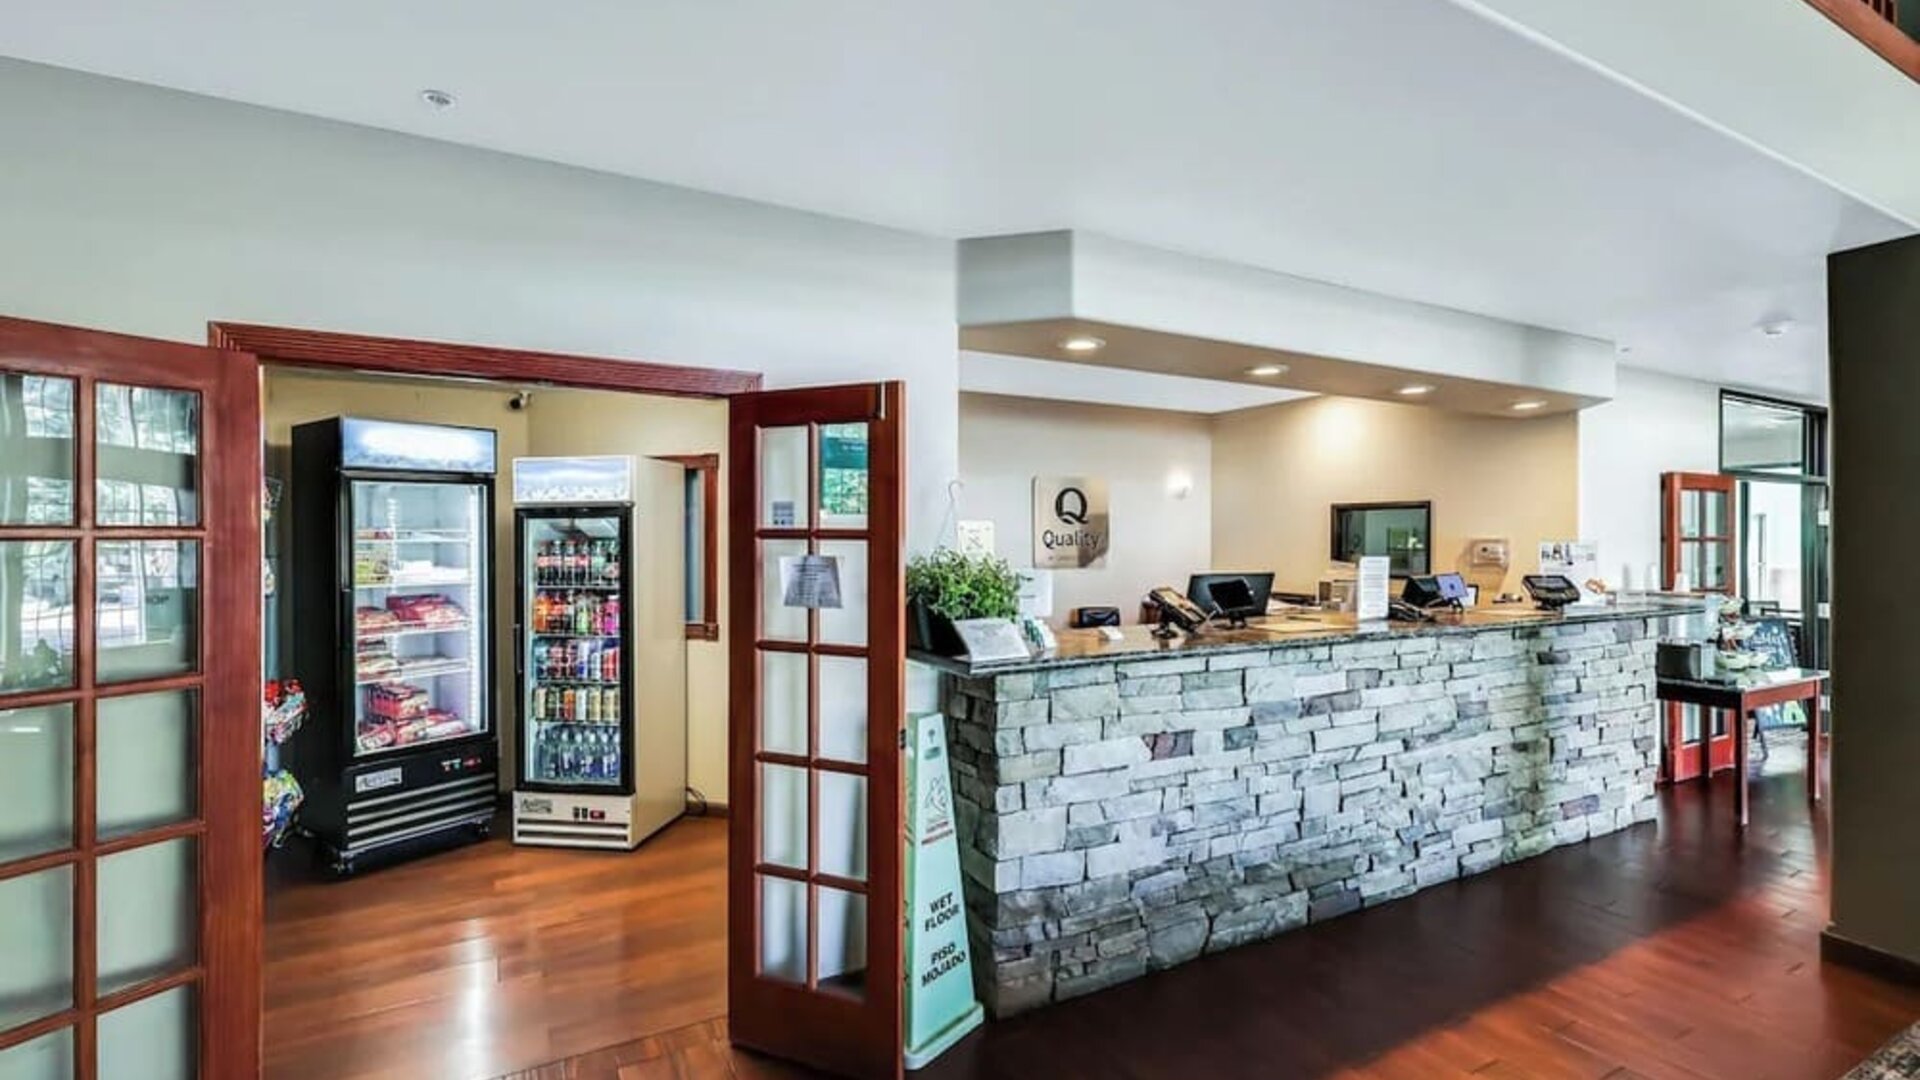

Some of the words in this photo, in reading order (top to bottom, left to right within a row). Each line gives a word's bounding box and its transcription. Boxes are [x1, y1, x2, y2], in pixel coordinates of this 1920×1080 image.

[1055, 487, 1089, 525] Q
[1042, 529, 1099, 550] Quality
[929, 892, 953, 914] WET
[924, 904, 960, 932] FLOOR
[931, 942, 956, 965] PISO
[921, 951, 967, 988] MOJADO
